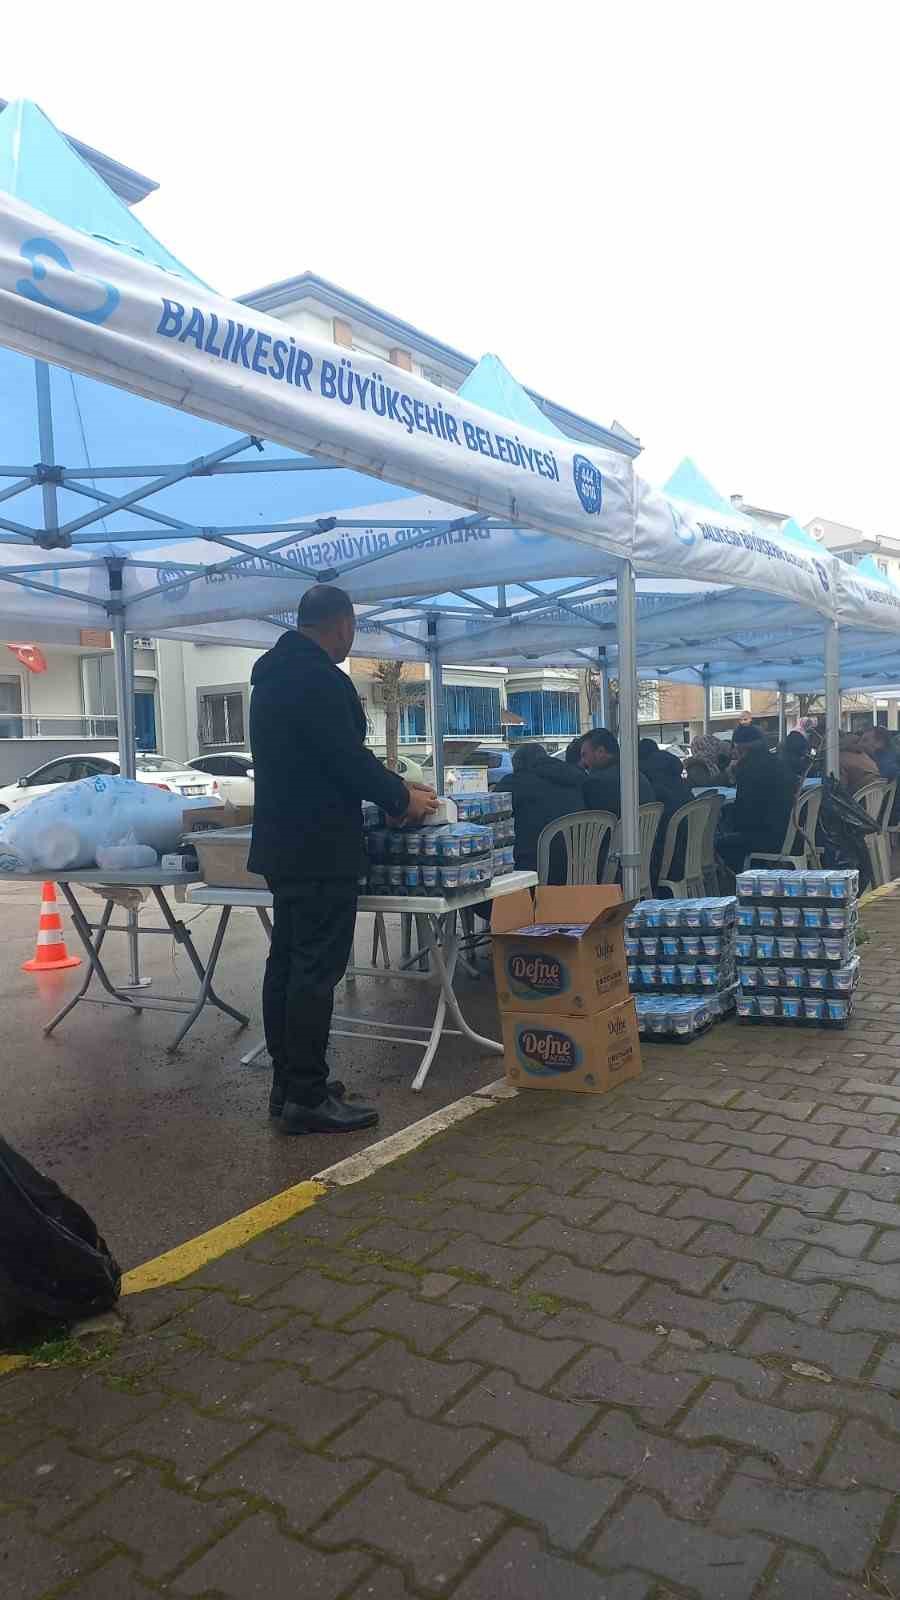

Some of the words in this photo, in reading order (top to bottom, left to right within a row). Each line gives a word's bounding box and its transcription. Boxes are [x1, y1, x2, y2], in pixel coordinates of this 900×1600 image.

[157, 297, 313, 392] BALIKESİR
[320, 358, 462, 446] BÜYÜKŞEHİR
[462, 420, 560, 482] BELEDİYESİ
[513, 957, 560, 984] Defne
[523, 1033, 571, 1060] Defne
